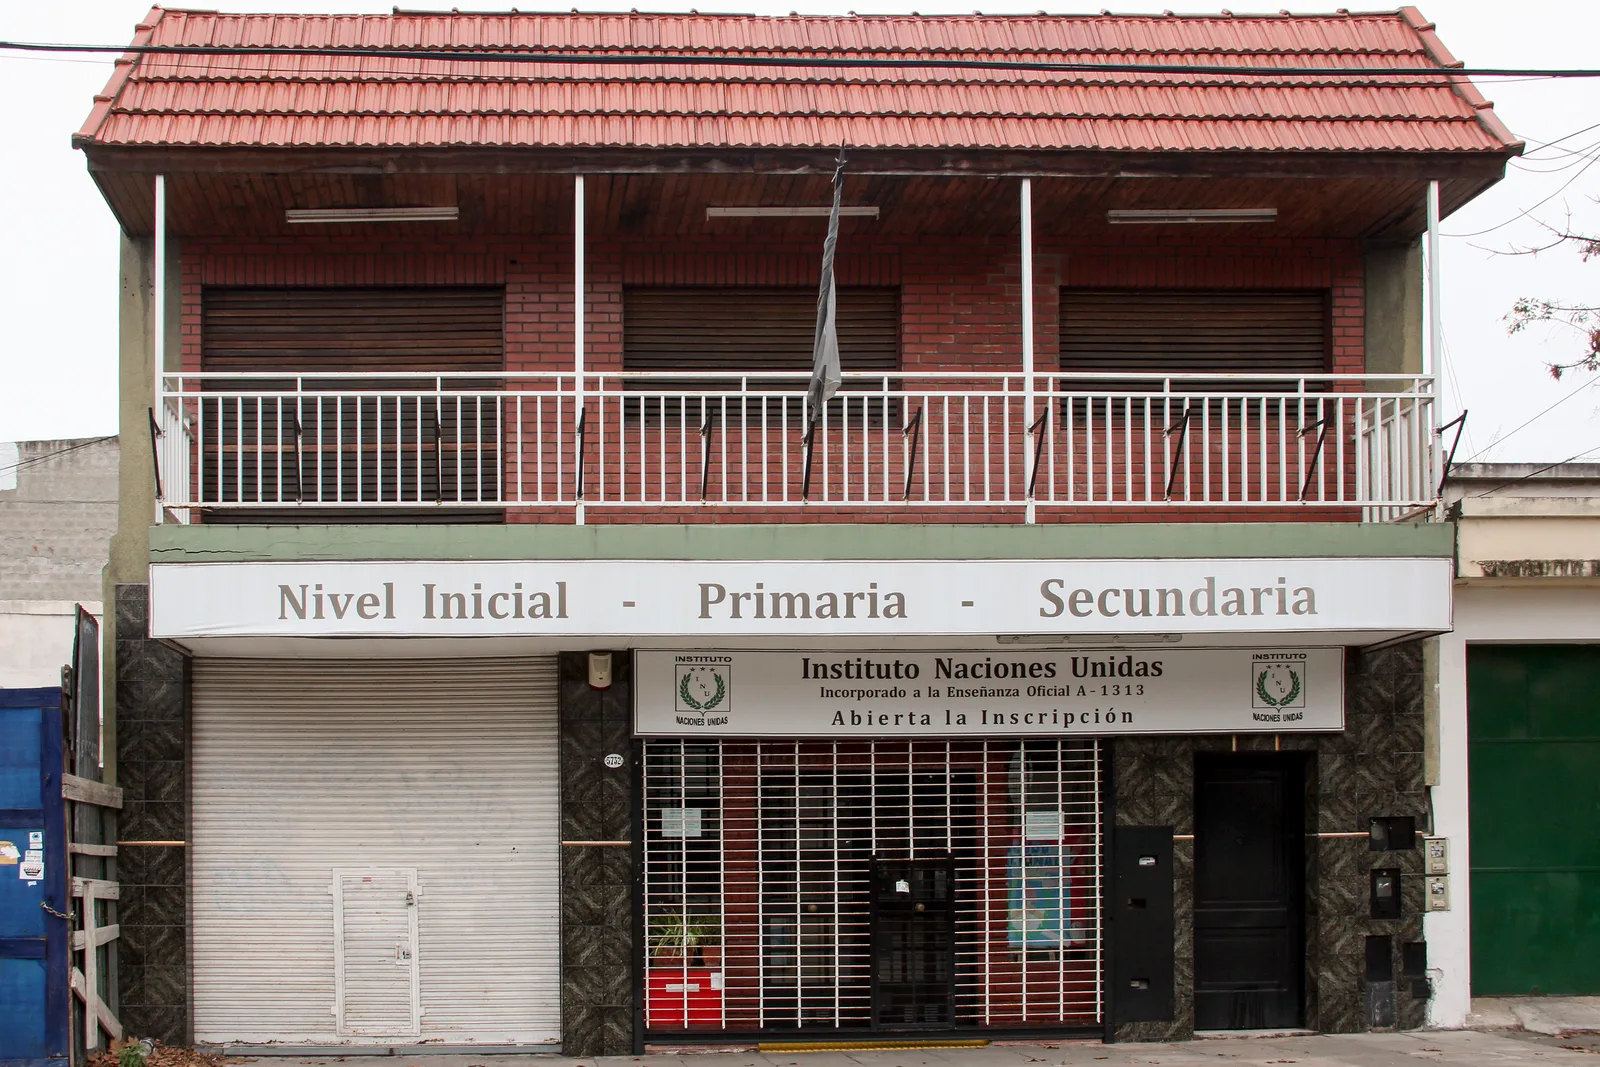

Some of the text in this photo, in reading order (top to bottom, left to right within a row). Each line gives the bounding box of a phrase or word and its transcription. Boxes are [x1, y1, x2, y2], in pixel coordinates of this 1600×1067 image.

[278, 582, 397, 620] Nivel
[422, 581, 570, 620] Inicial
[698, 582, 907, 620] Primaria
[1039, 576, 1319, 618] Secundaria
[675, 655, 732, 663] INSTITUTO
[801, 655, 1164, 680] Instituto Naciones Unidas
[820, 686, 907, 701] Incorporado
[912, 689, 921, 698] a
[927, 685, 941, 698] la
[947, 685, 1020, 698] Enseñanza
[1026, 684, 1071, 697] Oficial
[676, 716, 728, 726] NACIONES UNIDAS
[831, 709, 1134, 728] Abierta la Inscripción
[1252, 712, 1303, 722] NACIONES UNIDAS
